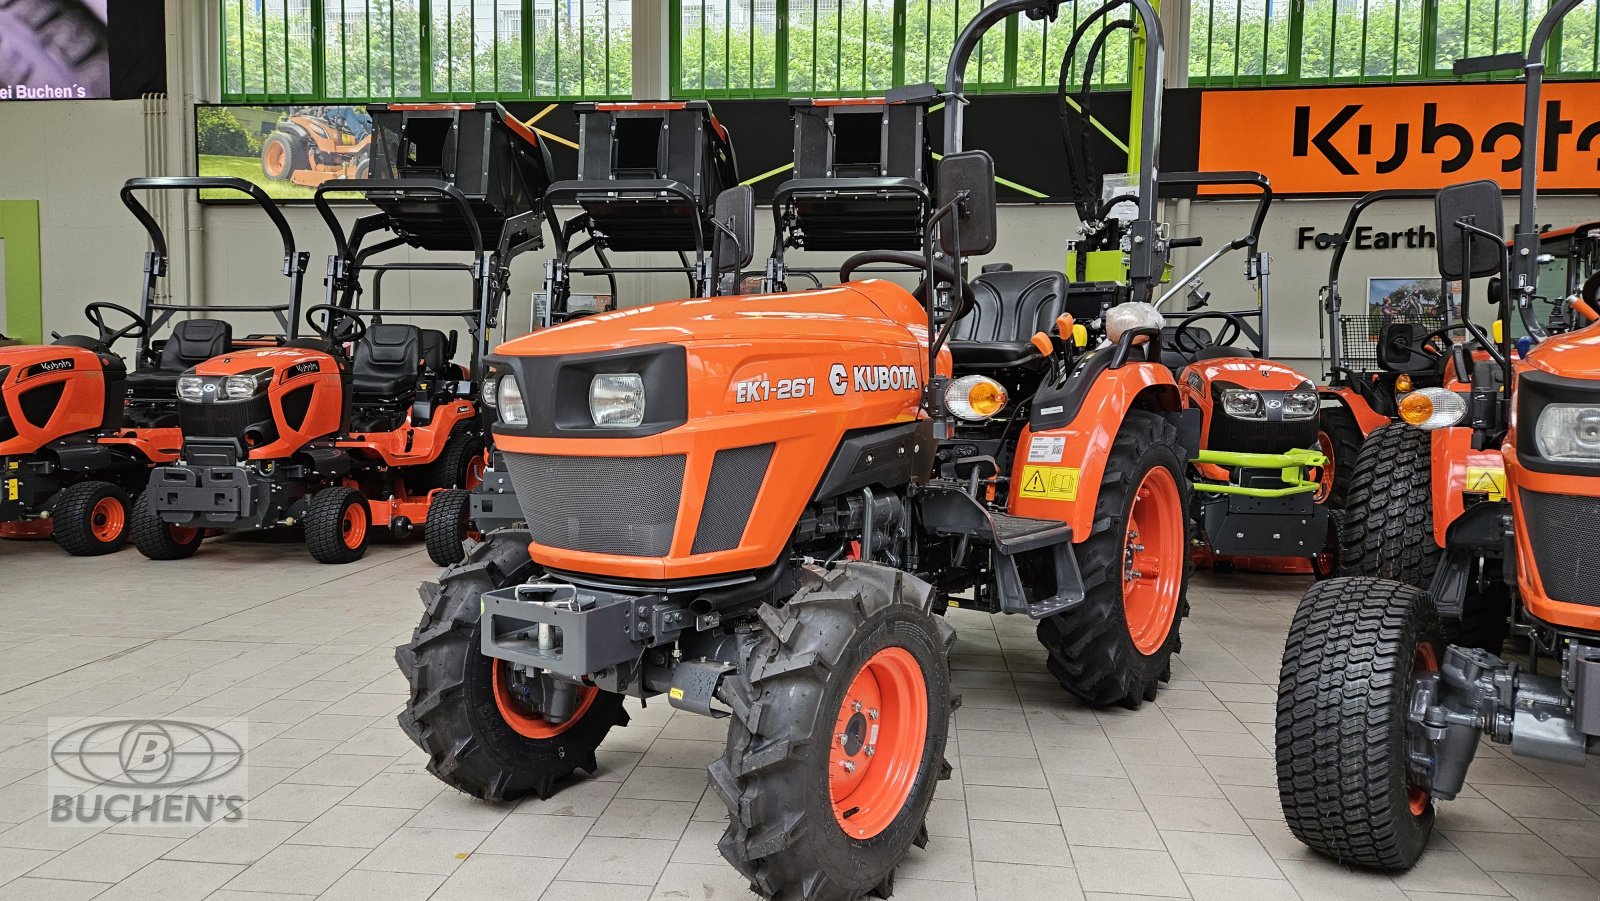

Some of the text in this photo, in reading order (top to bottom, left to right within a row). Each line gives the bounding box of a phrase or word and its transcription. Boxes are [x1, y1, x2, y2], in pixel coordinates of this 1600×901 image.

[1355, 225, 1435, 250] Earth
[41, 360, 72, 370] Kubota
[736, 377, 815, 403] EK1-261
[853, 365, 919, 392] KUBOTA
